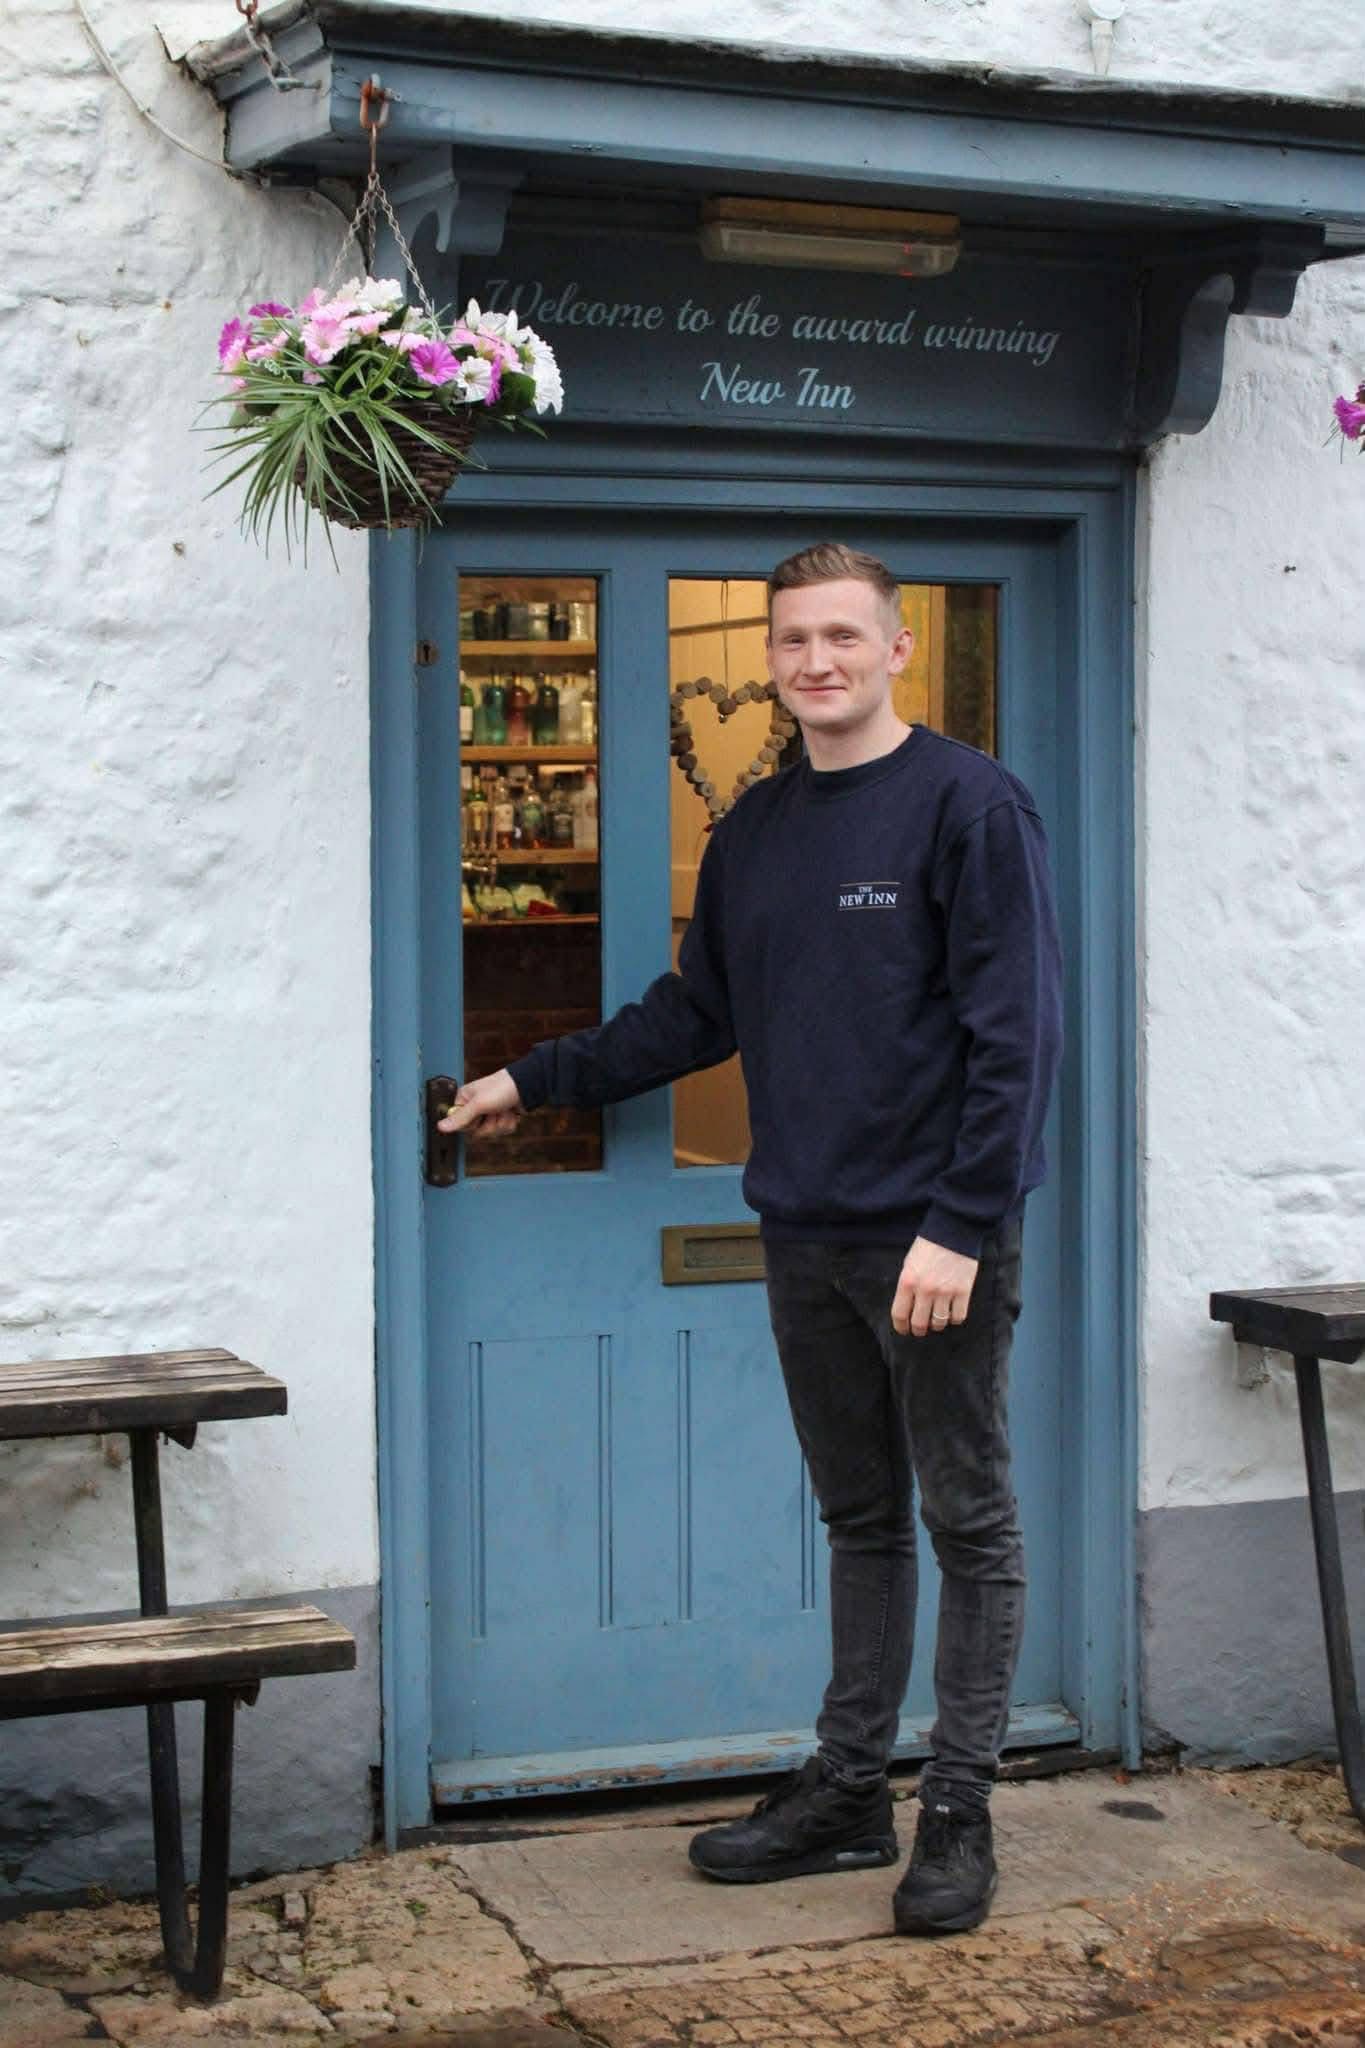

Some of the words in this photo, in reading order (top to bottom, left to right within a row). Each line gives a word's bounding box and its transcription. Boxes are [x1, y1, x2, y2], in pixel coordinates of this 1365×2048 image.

[484, 279, 665, 330] Welcome
[677, 299, 714, 333] to
[727, 294, 781, 337] the
[792, 310, 917, 345] award
[924, 317, 1060, 367] winning
[700, 362, 785, 405] New
[796, 367, 856, 409] Inn
[839, 894, 865, 907] NEW
[868, 892, 898, 905] INN
[858, 886, 873, 894] THE
